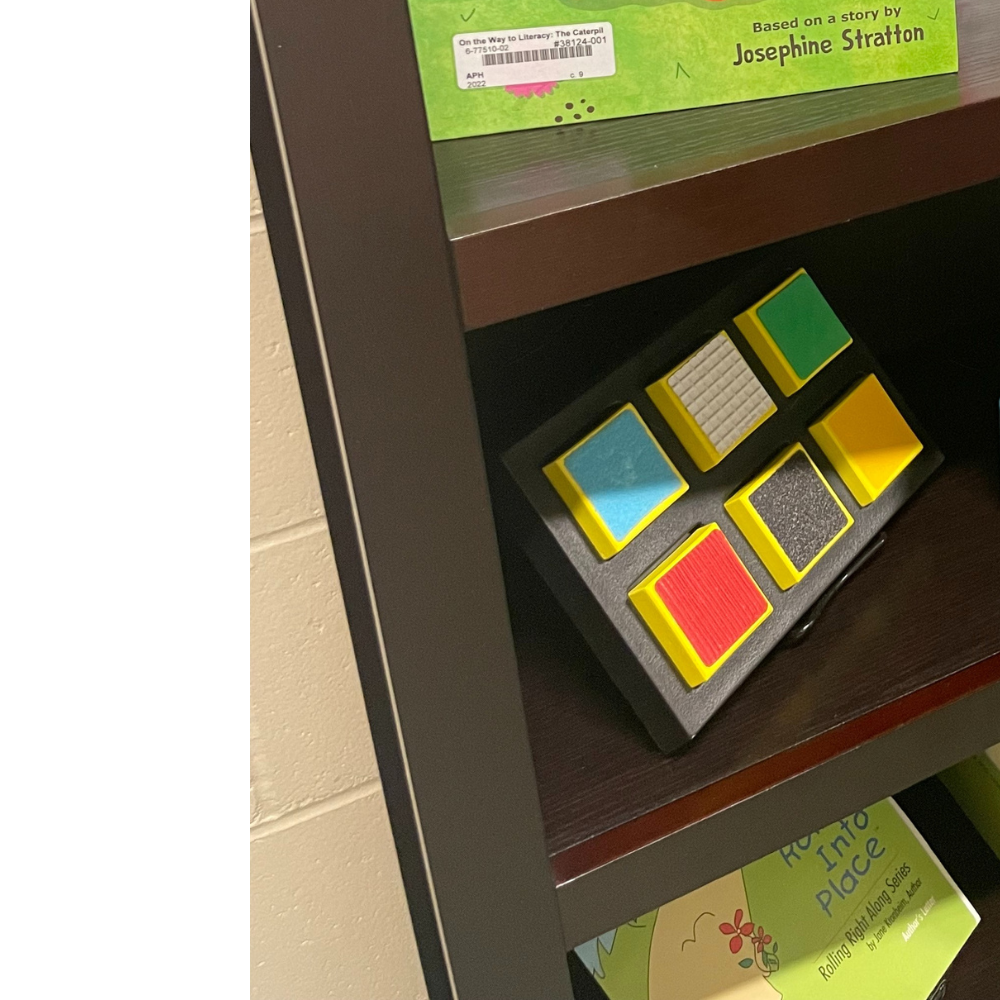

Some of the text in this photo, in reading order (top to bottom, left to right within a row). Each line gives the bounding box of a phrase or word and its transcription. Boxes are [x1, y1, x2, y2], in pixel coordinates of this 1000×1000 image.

[752, 6, 901, 33] Based on a story by
[459, 38, 472, 47] On
[473, 37, 487, 45] the
[488, 35, 506, 45] Way
[518, 31, 554, 42] Literacy:
[555, 30, 571, 38] The
[465, 36, 607, 55] 6-77510-02 #38124-001
[733, 23, 924, 67] Josephine Stratton
[466, 71, 484, 80] APH
[467, 80, 486, 89] 2022
[816, 809, 869, 872] Into
[815, 837, 886, 918] Place
[818, 861, 911, 981] Rolling Right Along Series
[901, 913, 924, 943] Author's
[866, 941, 878, 951] by
